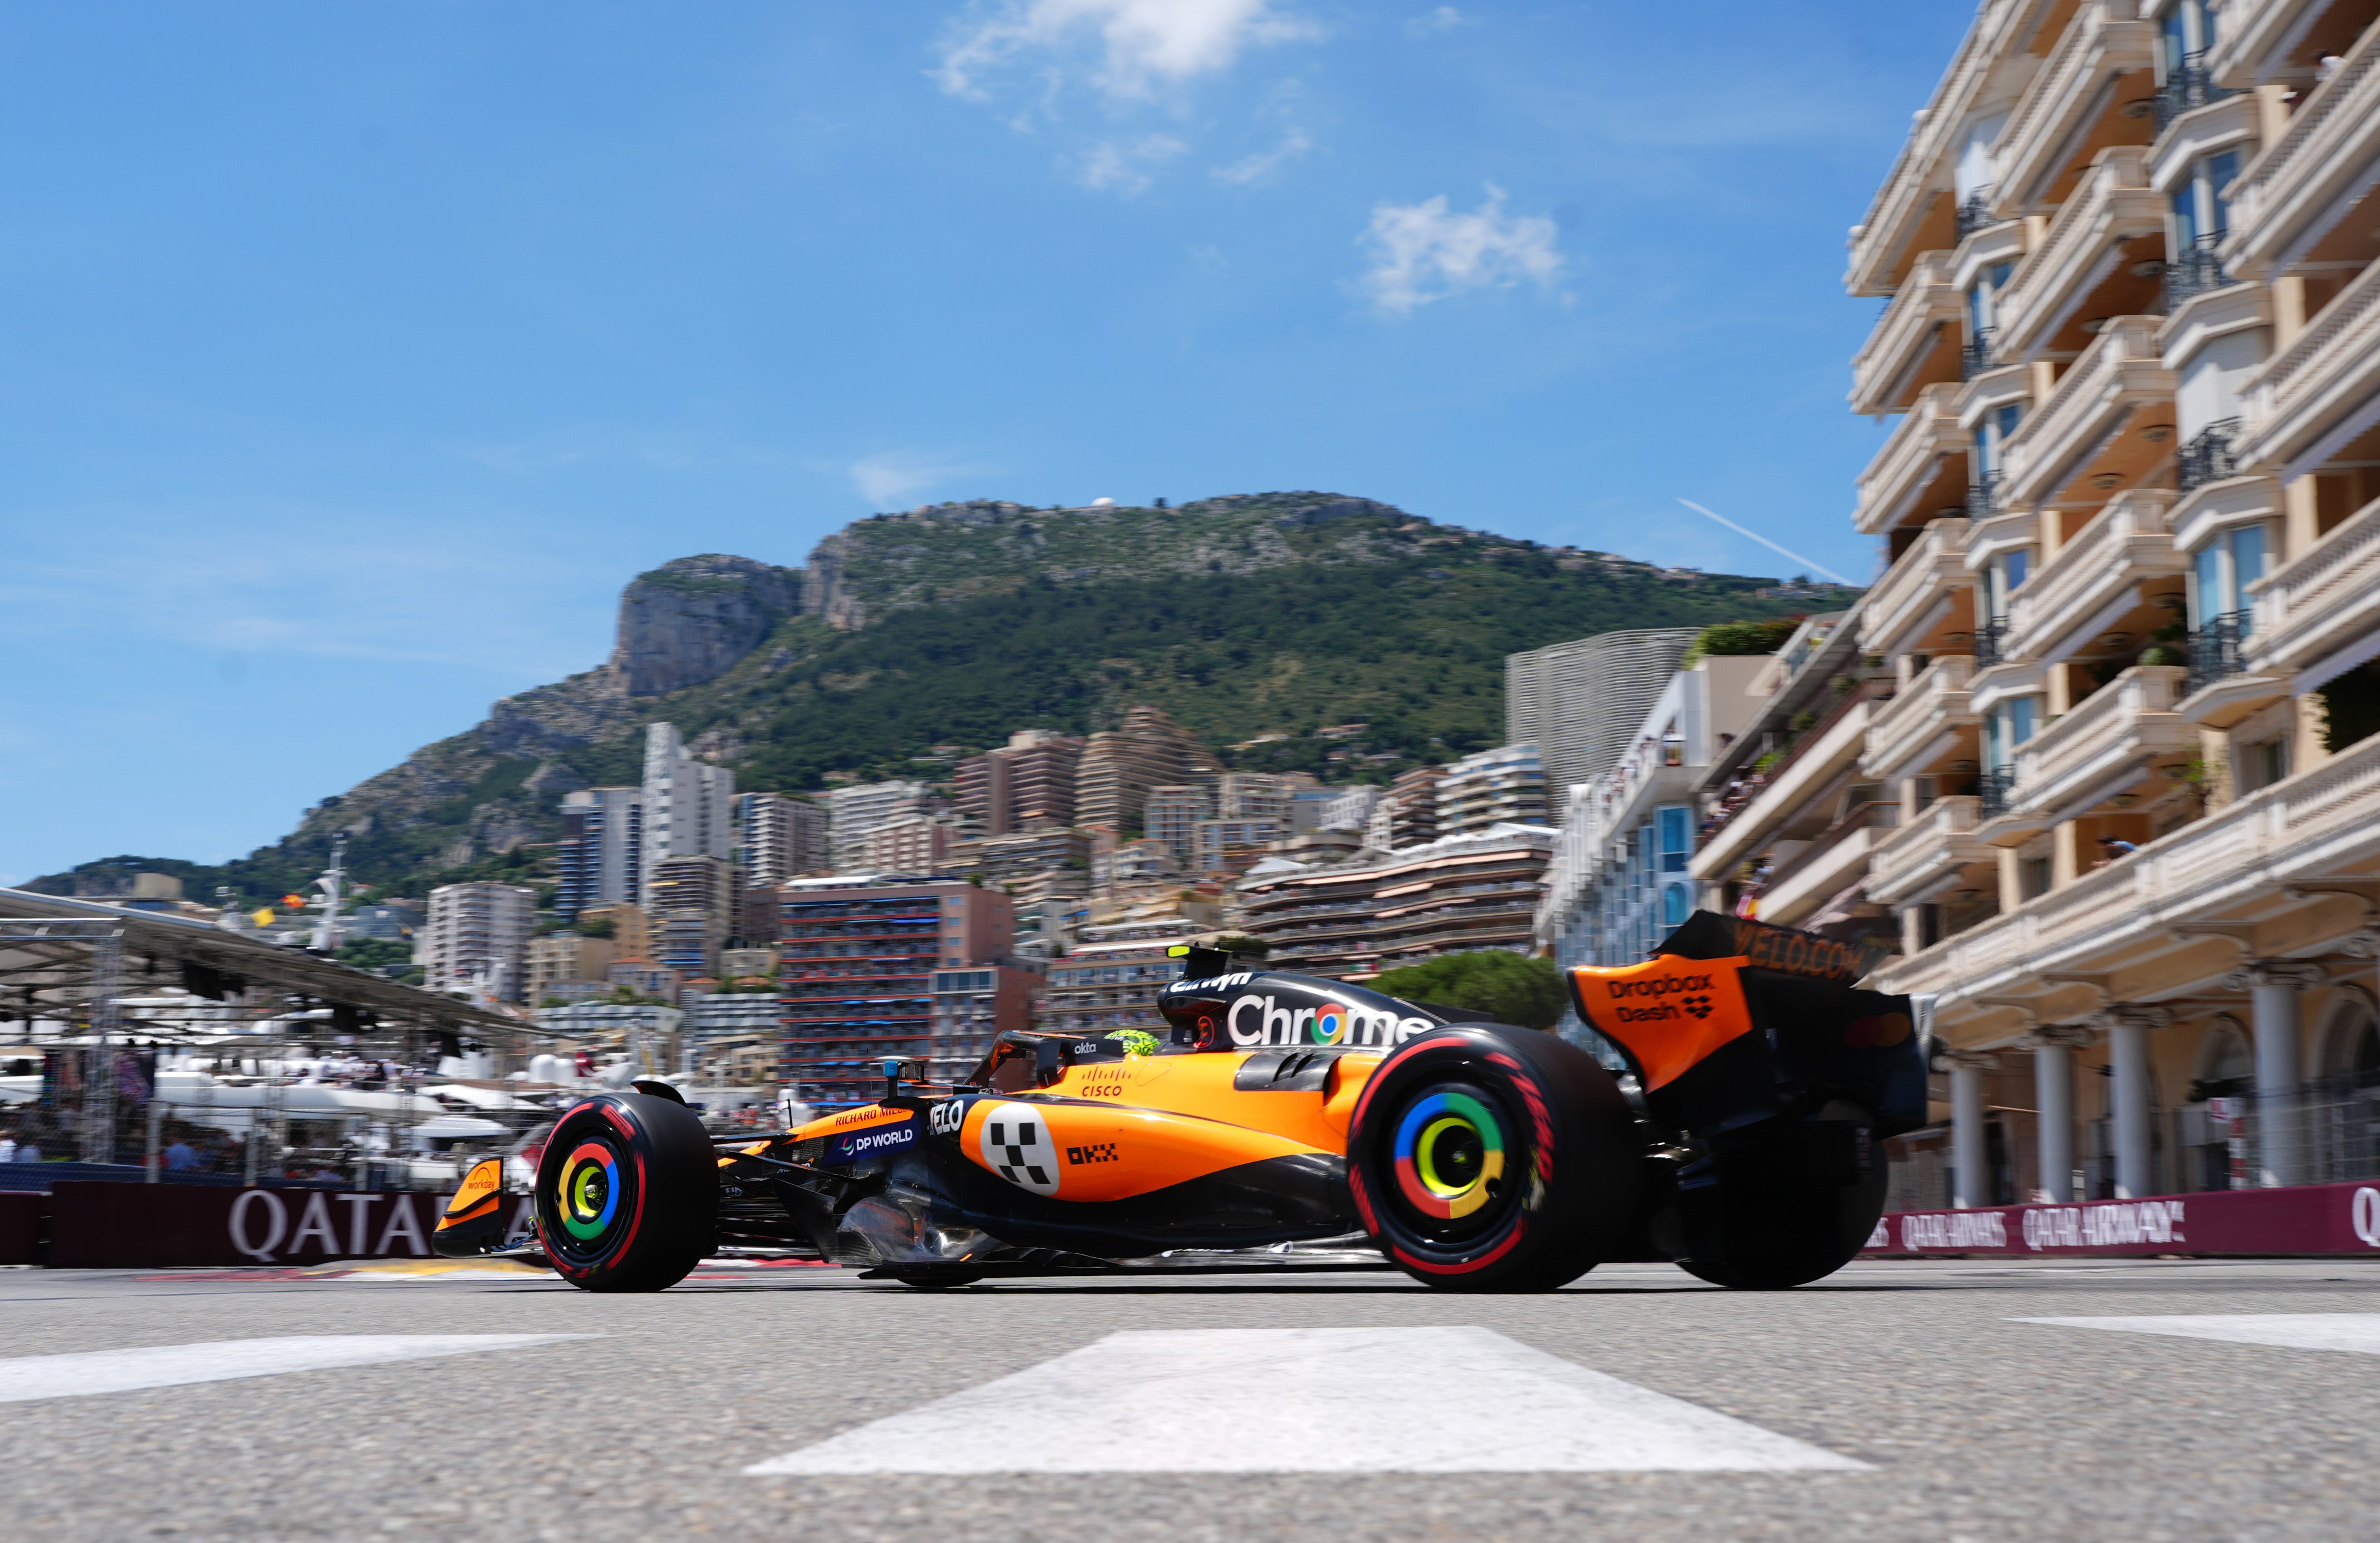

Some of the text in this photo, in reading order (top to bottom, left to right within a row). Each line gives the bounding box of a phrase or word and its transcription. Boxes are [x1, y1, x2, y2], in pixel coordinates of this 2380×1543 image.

[1608, 973, 1716, 1000] Dropbox
[1228, 994, 1435, 1045] Chrome
[1615, 1001, 1680, 1023] Dash
[1074, 1042, 1097, 1054] okta
[1082, 1086, 1122, 1097] CISCO
[835, 1110, 876, 1126] RICHARD
[856, 1137, 871, 1151] DP
[872, 1129, 912, 1147] WORLD
[1066, 1143, 1119, 1165] OKX
[468, 1179, 495, 1191] workday
